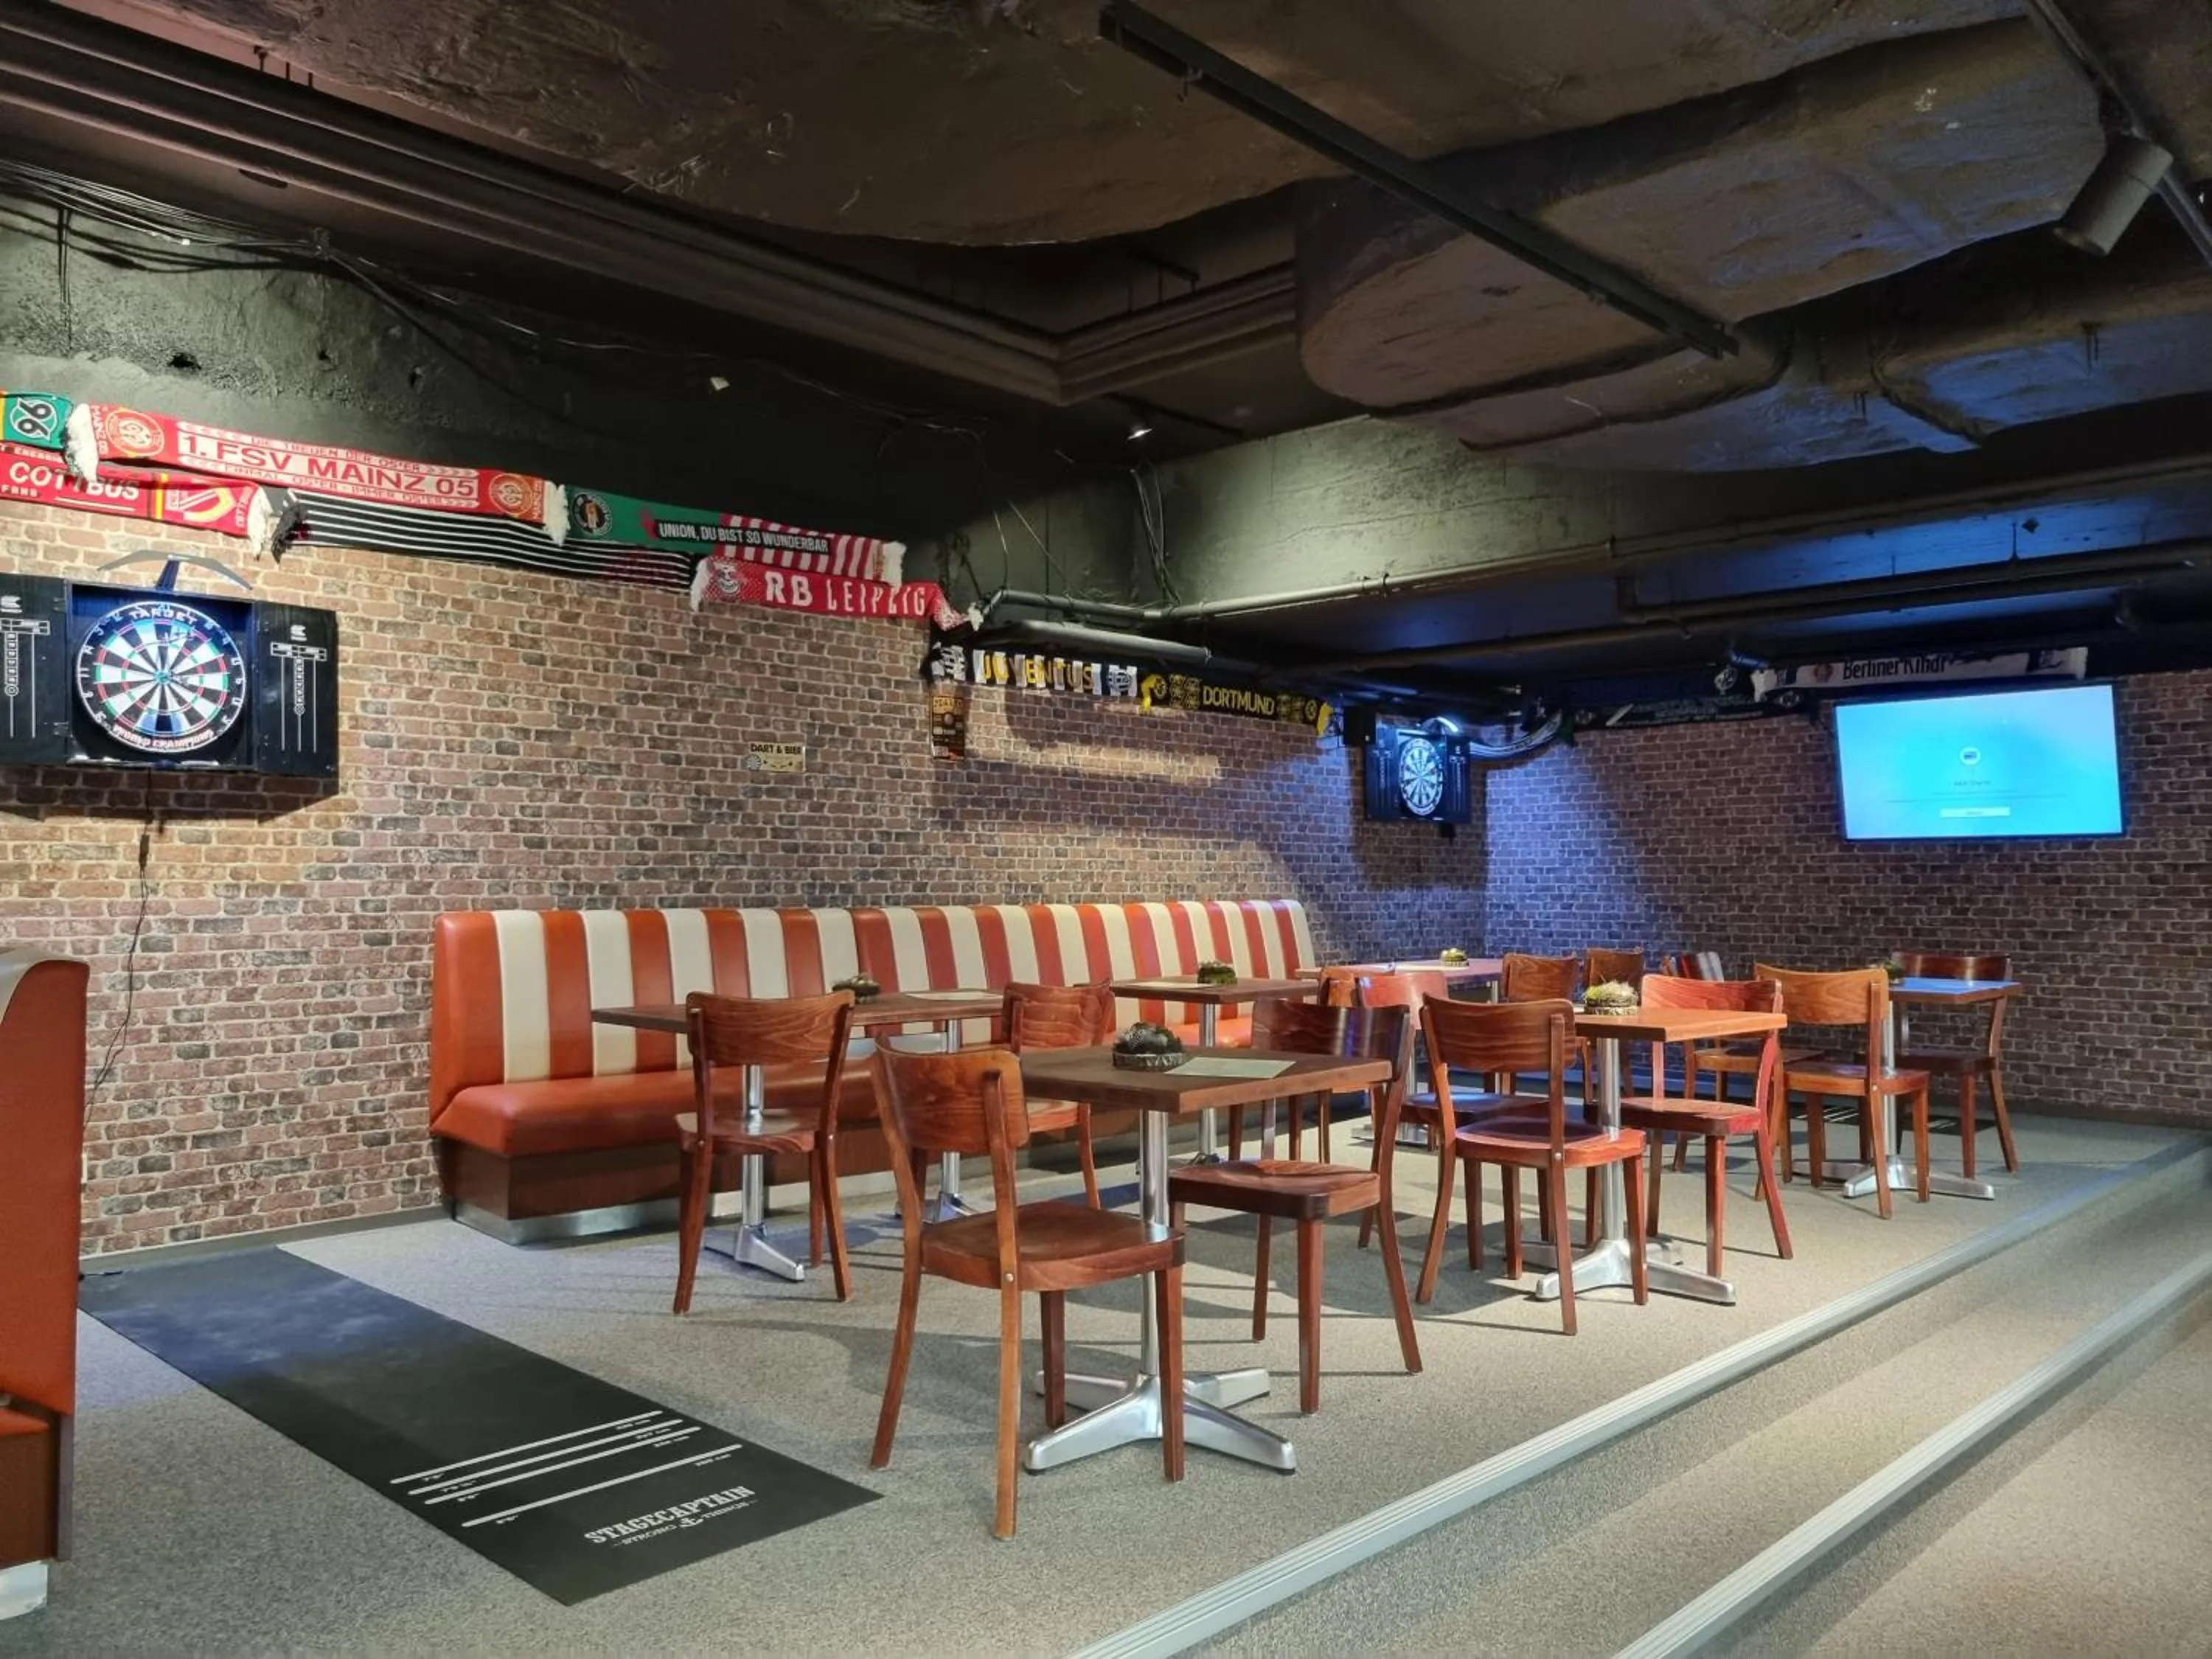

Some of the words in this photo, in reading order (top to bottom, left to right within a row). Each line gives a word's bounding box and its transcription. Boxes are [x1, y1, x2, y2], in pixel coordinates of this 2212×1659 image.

[182, 436, 206, 456] 1.
[216, 441, 292, 470] FSV
[307, 457, 426, 492] MAINZ
[436, 478, 474, 497] 05
[658, 522, 700, 541] UNION,
[700, 526, 717, 541] DU
[717, 527, 744, 542] BIST
[746, 530, 760, 545] SO
[762, 532, 829, 552] WUNDERBAR
[764, 571, 813, 607] RB
[825, 578, 925, 616] LEIPZIG
[983, 653, 1095, 689] JUVENTUS
[1843, 658, 1899, 680] Berliner
[1203, 686, 1275, 715] DORTMUND
[584, 1486, 756, 1543] STAGECAPTAIN
